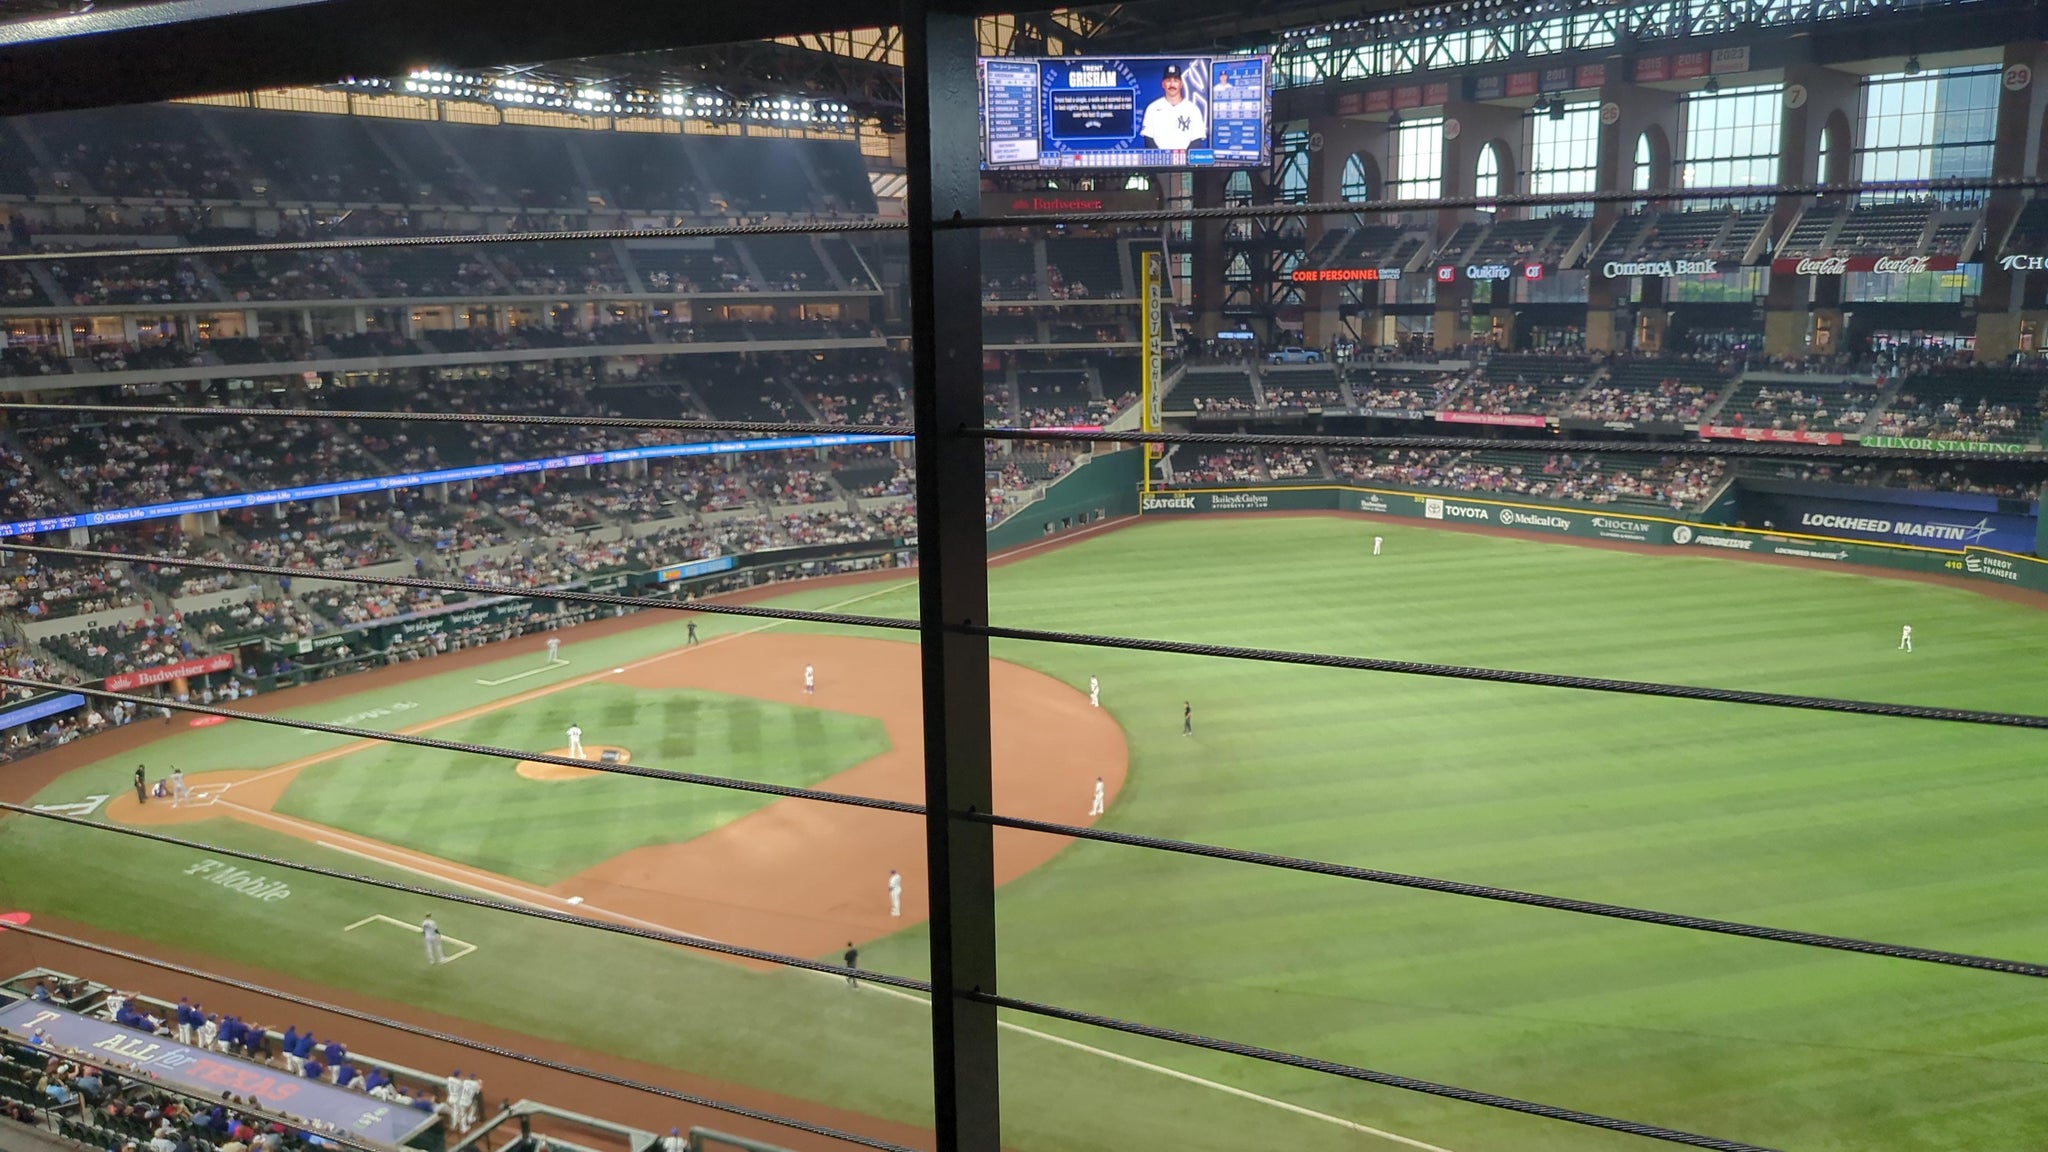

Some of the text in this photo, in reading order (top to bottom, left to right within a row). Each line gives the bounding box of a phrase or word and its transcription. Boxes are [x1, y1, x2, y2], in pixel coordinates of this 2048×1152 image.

[1069, 71, 1117, 87] GRISHAM
[2006, 70, 2027, 85] 29
[1792, 90, 1800, 104] 7
[1440, 268, 1452, 279] QT
[1466, 264, 1510, 280] QuikTrip
[1525, 266, 1540, 278] QT
[1675, 259, 1717, 274] Bank
[1292, 268, 1378, 281] CORE PERSONNEL
[1150, 287, 1160, 424] ROOT 4 CHIKIN
[1876, 437, 2022, 453] LUXOR STAFFING
[256, 491, 290, 501] Globe Life
[1143, 497, 1196, 510] SEATGEEK
[105, 510, 144, 521] Globe Life
[1445, 505, 1489, 519] TOYOTA
[1515, 513, 1571, 531] Medical City
[1597, 517, 1650, 532] CHOCTAW
[1802, 513, 1966, 541] LOCKHEED MARTIN
[1694, 535, 1753, 550] PROGRESSIVE
[1775, 547, 1838, 560] LOCKHEED MARTIN
[1944, 561, 1962, 570] 410
[1983, 557, 2012, 570] ENERGY
[1983, 565, 2018, 580] TRANSFER
[314, 636, 344, 648] TOYOTA
[138, 664, 205, 685] Budweiser
[21, 1009, 61, 1029] T
[93, 1033, 300, 1101] ALL for TEXAS
